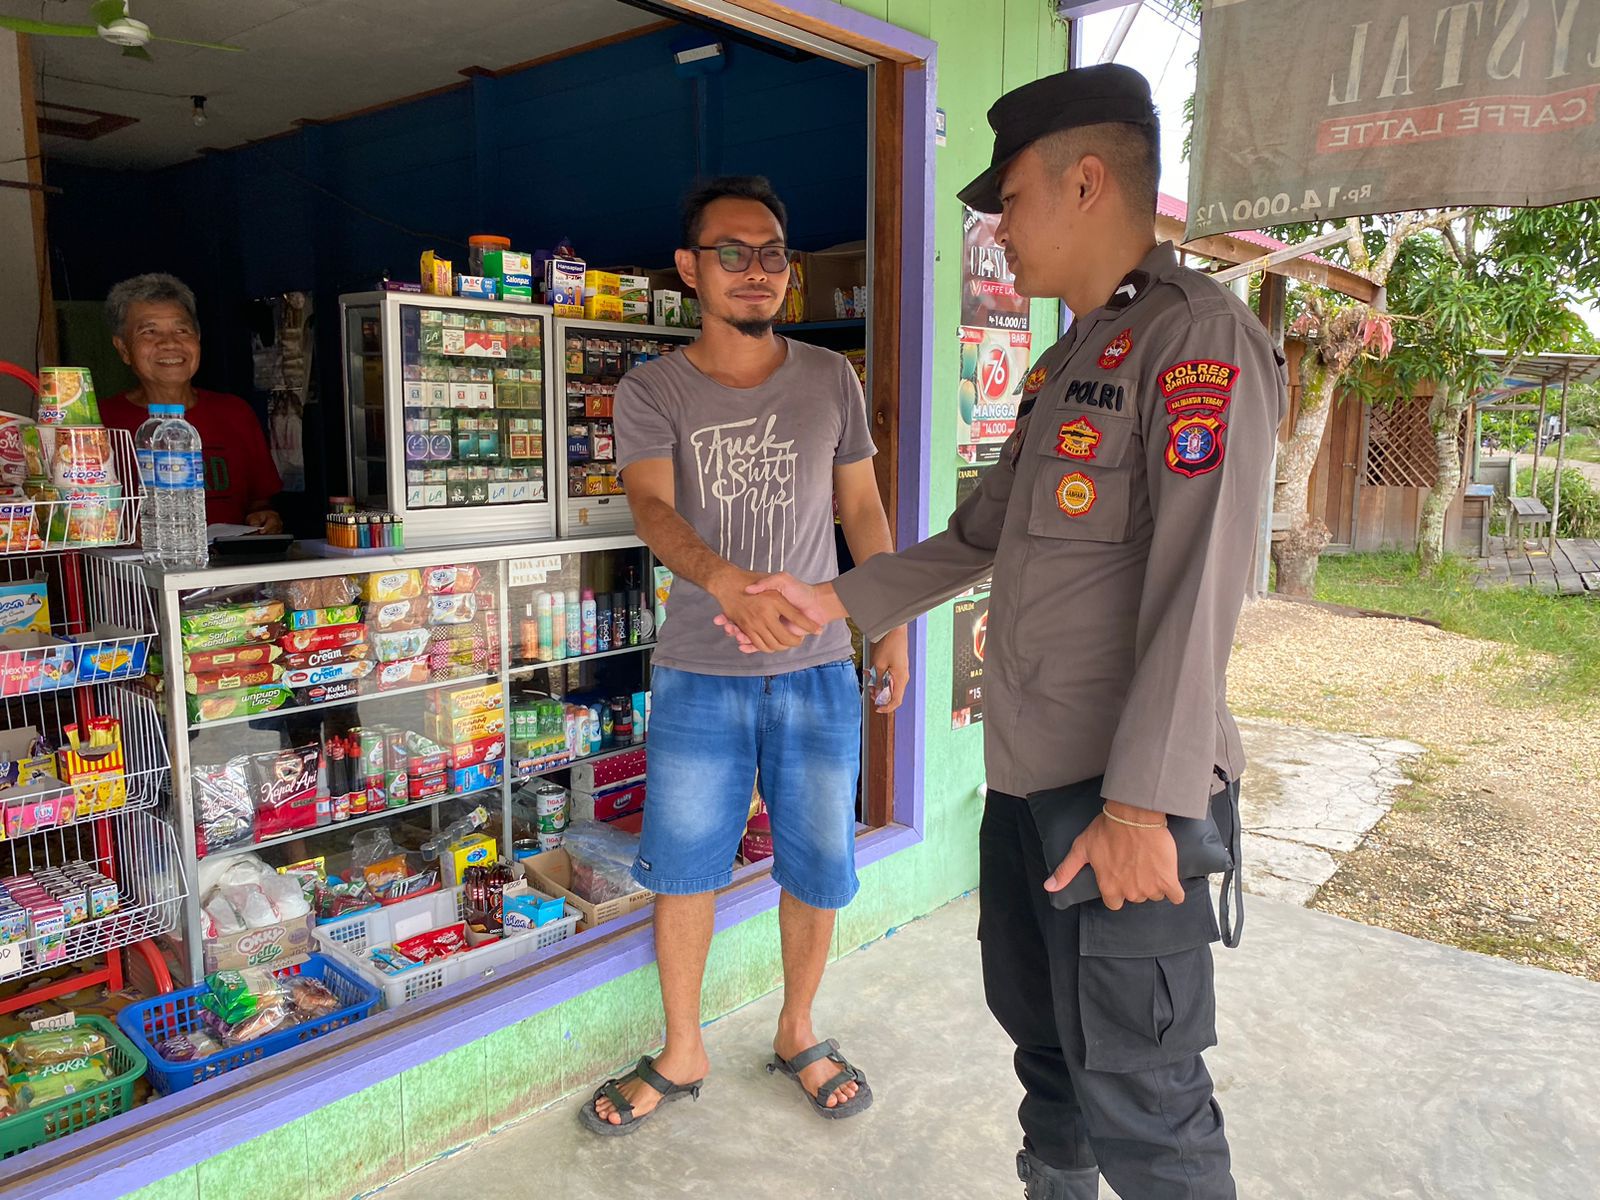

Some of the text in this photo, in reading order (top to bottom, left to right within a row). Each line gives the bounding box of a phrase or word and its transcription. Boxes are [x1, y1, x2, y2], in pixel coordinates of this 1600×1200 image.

[557, 263, 584, 272] Hansaplast
[463, 276, 480, 286] ABC
[505, 274, 530, 286] Salonpas
[1011, 333, 1030, 344] BARU
[983, 350, 1006, 394] 76
[1165, 363, 1230, 385] POLRES
[1165, 373, 1229, 392] BARITO UTARA
[1064, 380, 1124, 412] POLRI
[972, 404, 1016, 419] MANGGA
[984, 423, 1007, 434] 14.000
[492, 487, 505, 499] LA
[512, 489, 525, 498] LA
[511, 573, 546, 584] PULSA
[598, 619, 612, 642] posh
[616, 617, 627, 639] posh
[208, 630, 227, 640] Sari
[200, 636, 238, 648] Gandum
[308, 648, 343, 666] Cream
[310, 667, 344, 684] Cream
[327, 684, 348, 694] Kukis
[241, 689, 280, 702] Gandum
[251, 698, 272, 708] Sari
[261, 770, 318, 804] Kapal Api
